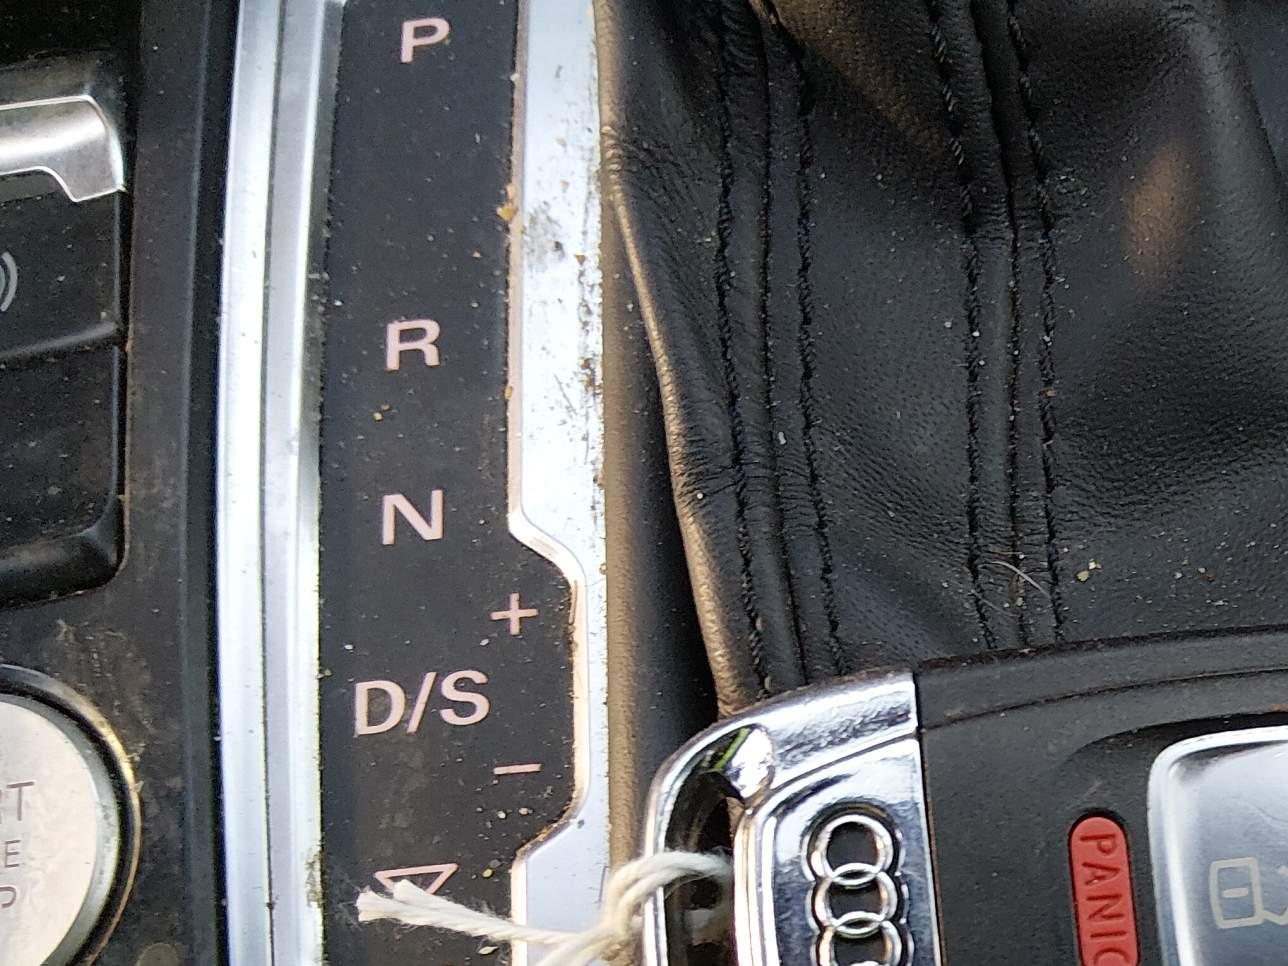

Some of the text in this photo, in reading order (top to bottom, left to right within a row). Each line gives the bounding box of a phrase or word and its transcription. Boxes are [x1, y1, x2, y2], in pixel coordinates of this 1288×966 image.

[400, 17, 451, 63] P
[384, 318, 442, 372] R
[381, 489, 444, 546] N
[353, 668, 491, 738] D/S
[1079, 833, 1131, 966] PANIC
